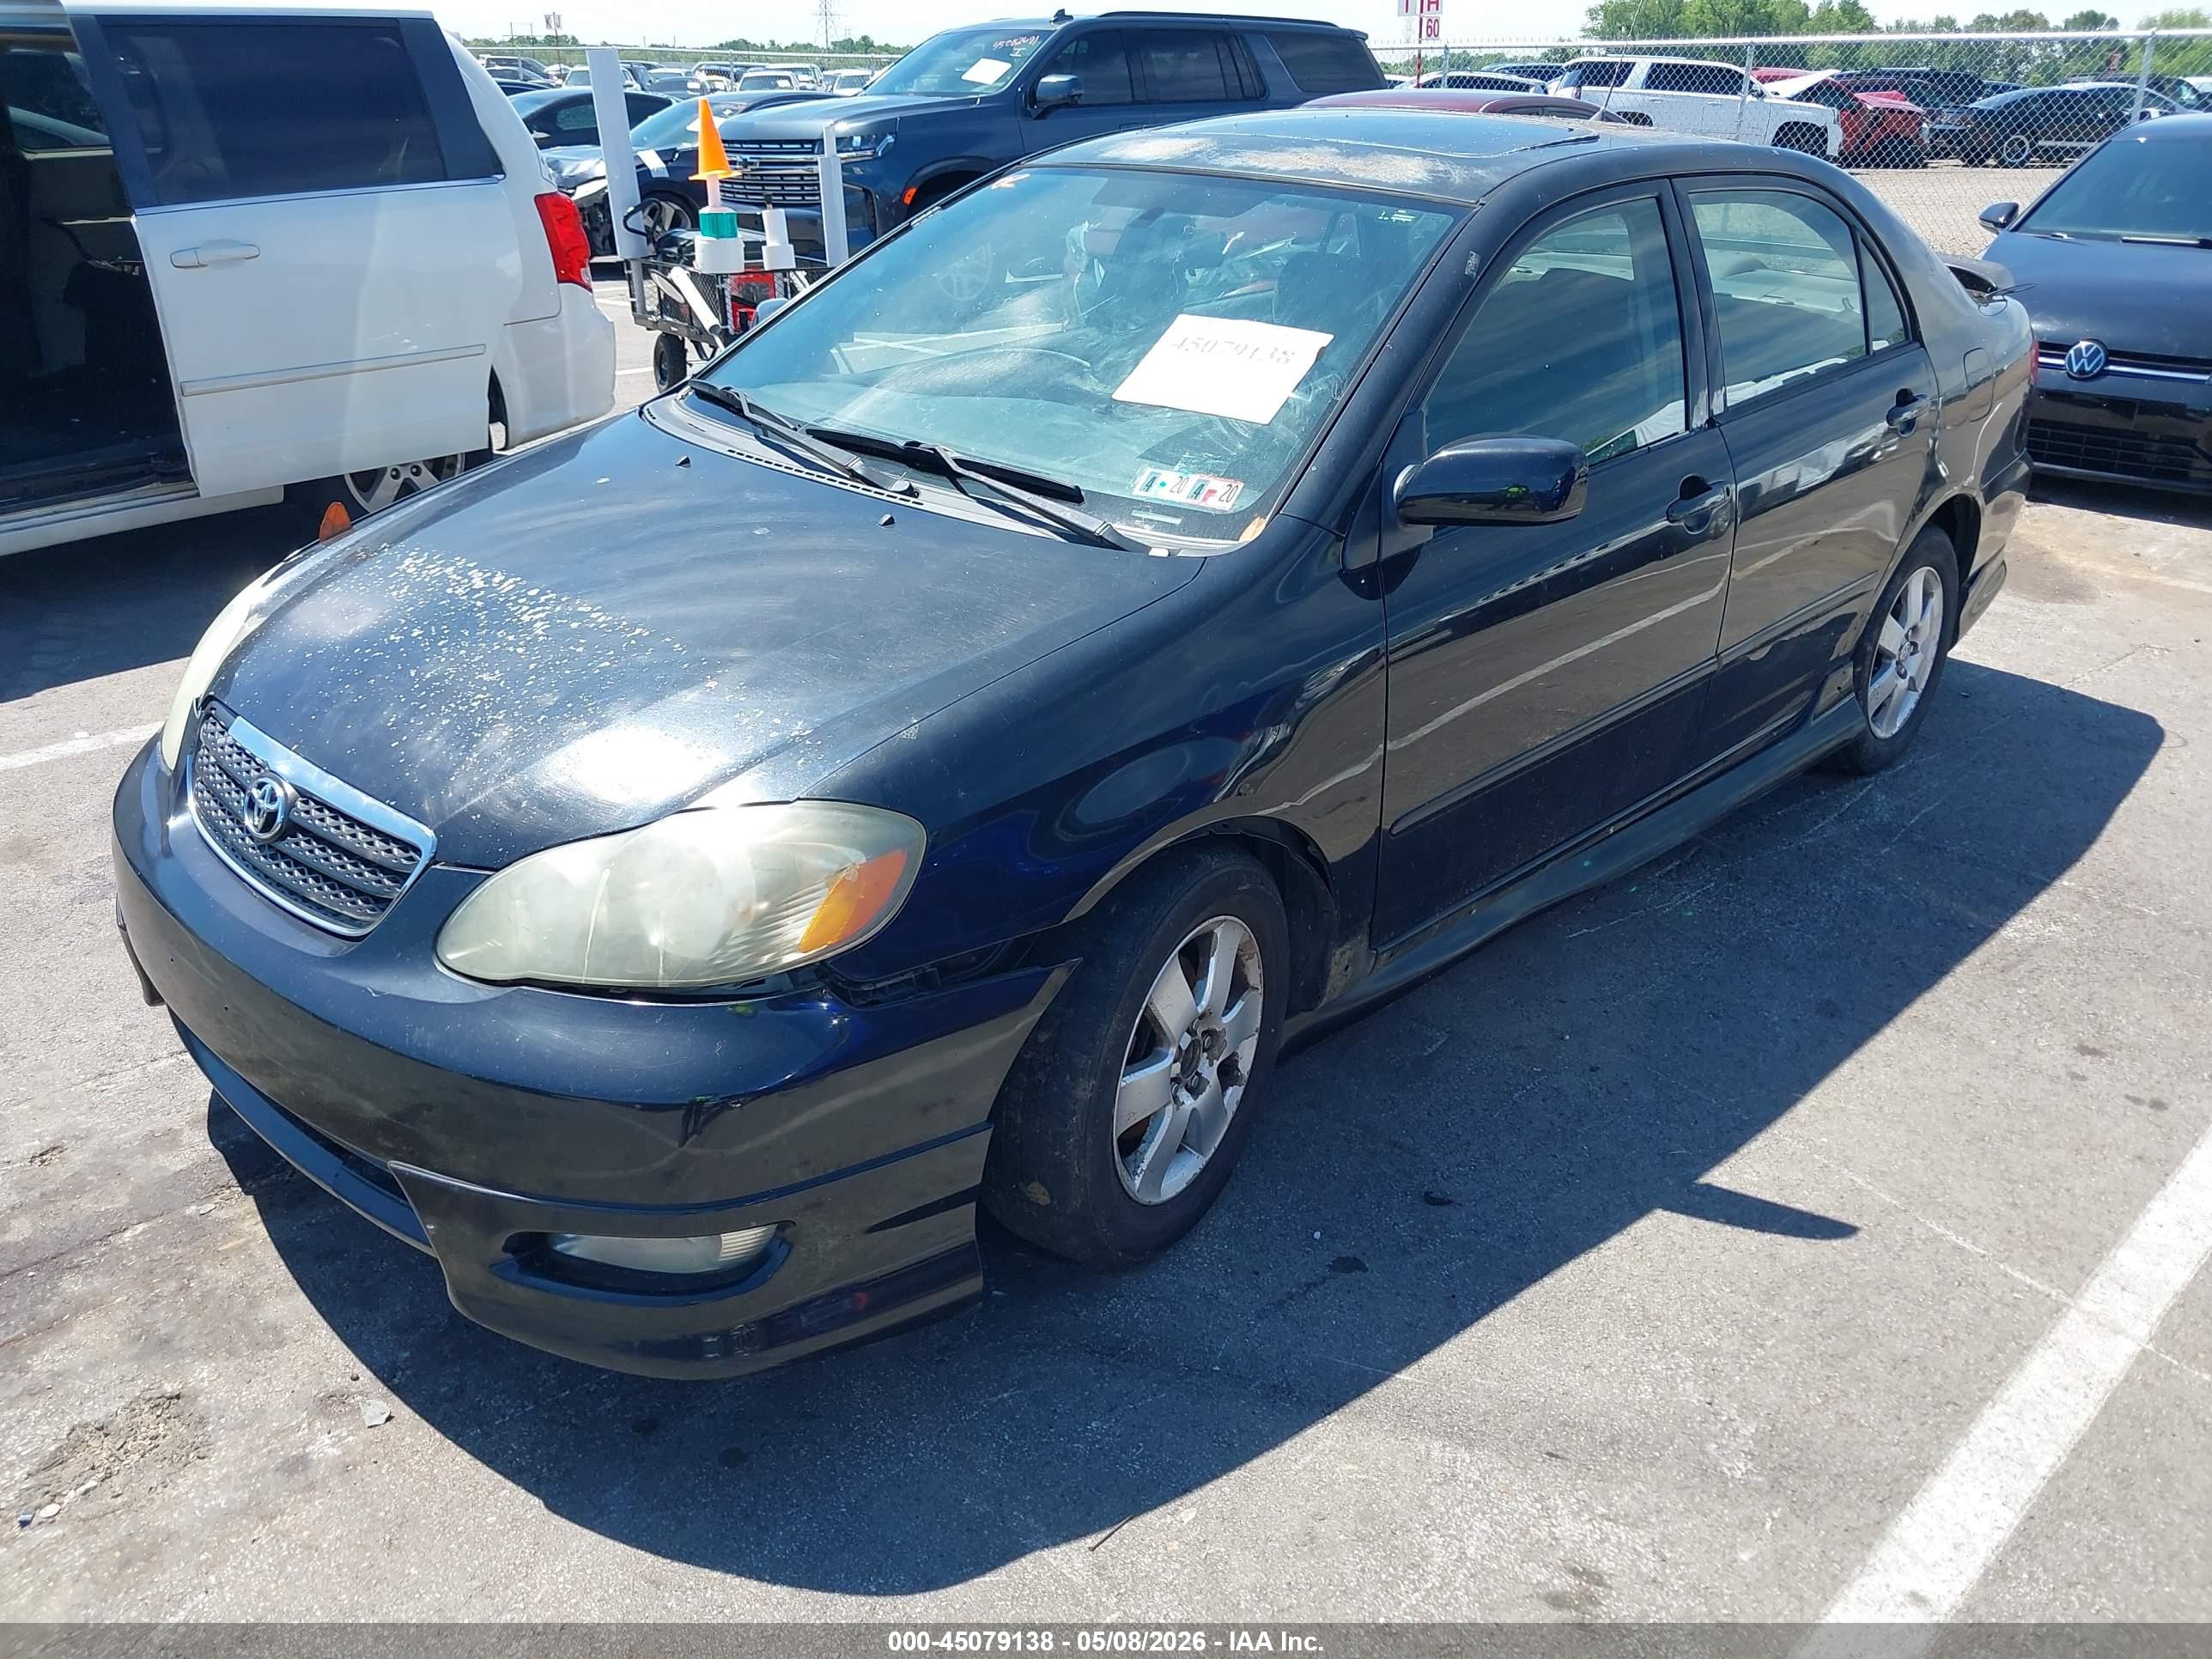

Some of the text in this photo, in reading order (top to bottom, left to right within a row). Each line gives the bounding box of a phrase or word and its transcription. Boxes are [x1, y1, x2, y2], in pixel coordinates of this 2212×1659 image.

[544, 14, 552, 28] K
[1426, 18, 1440, 38] 60
[1143, 475, 1189, 495] 4 20
[1191, 483, 1239, 503] 4 20
